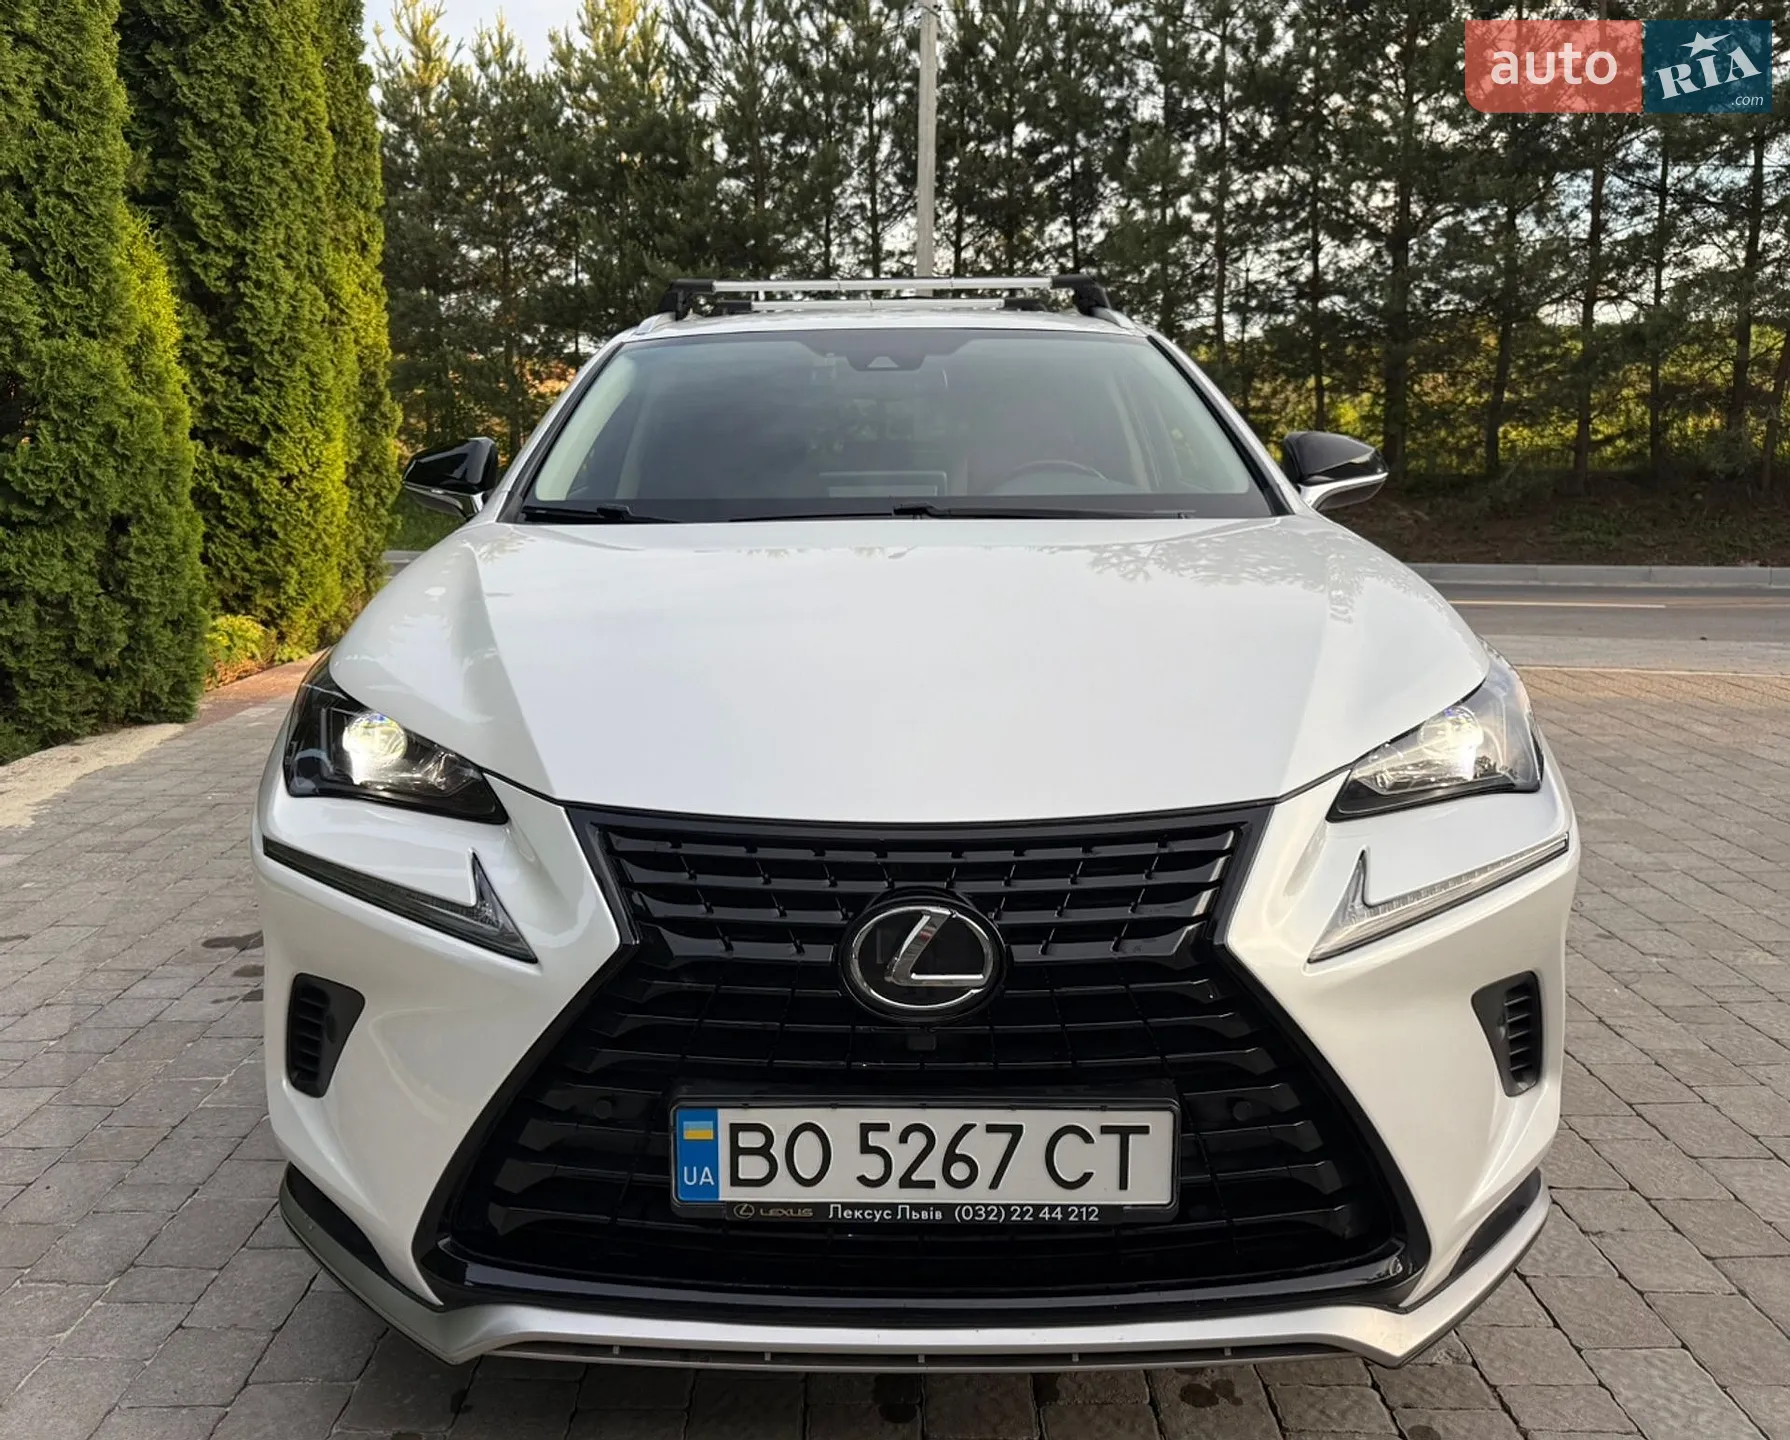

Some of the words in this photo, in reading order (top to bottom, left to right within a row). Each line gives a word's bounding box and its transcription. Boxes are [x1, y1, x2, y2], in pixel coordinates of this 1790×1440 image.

[729, 1121, 833, 1188] BO
[856, 1122, 1025, 1191] 5267
[1044, 1124, 1151, 1191] CT
[683, 1166, 716, 1187] UA
[759, 1207, 814, 1218] LEXUS
[828, 1203, 893, 1223] Лексус
[896, 1204, 943, 1220] Львів
[954, 1205, 1006, 1223] (032)
[1010, 1205, 1034, 1221] 22
[1039, 1205, 1064, 1221] 44
[1067, 1205, 1100, 1222] 212
